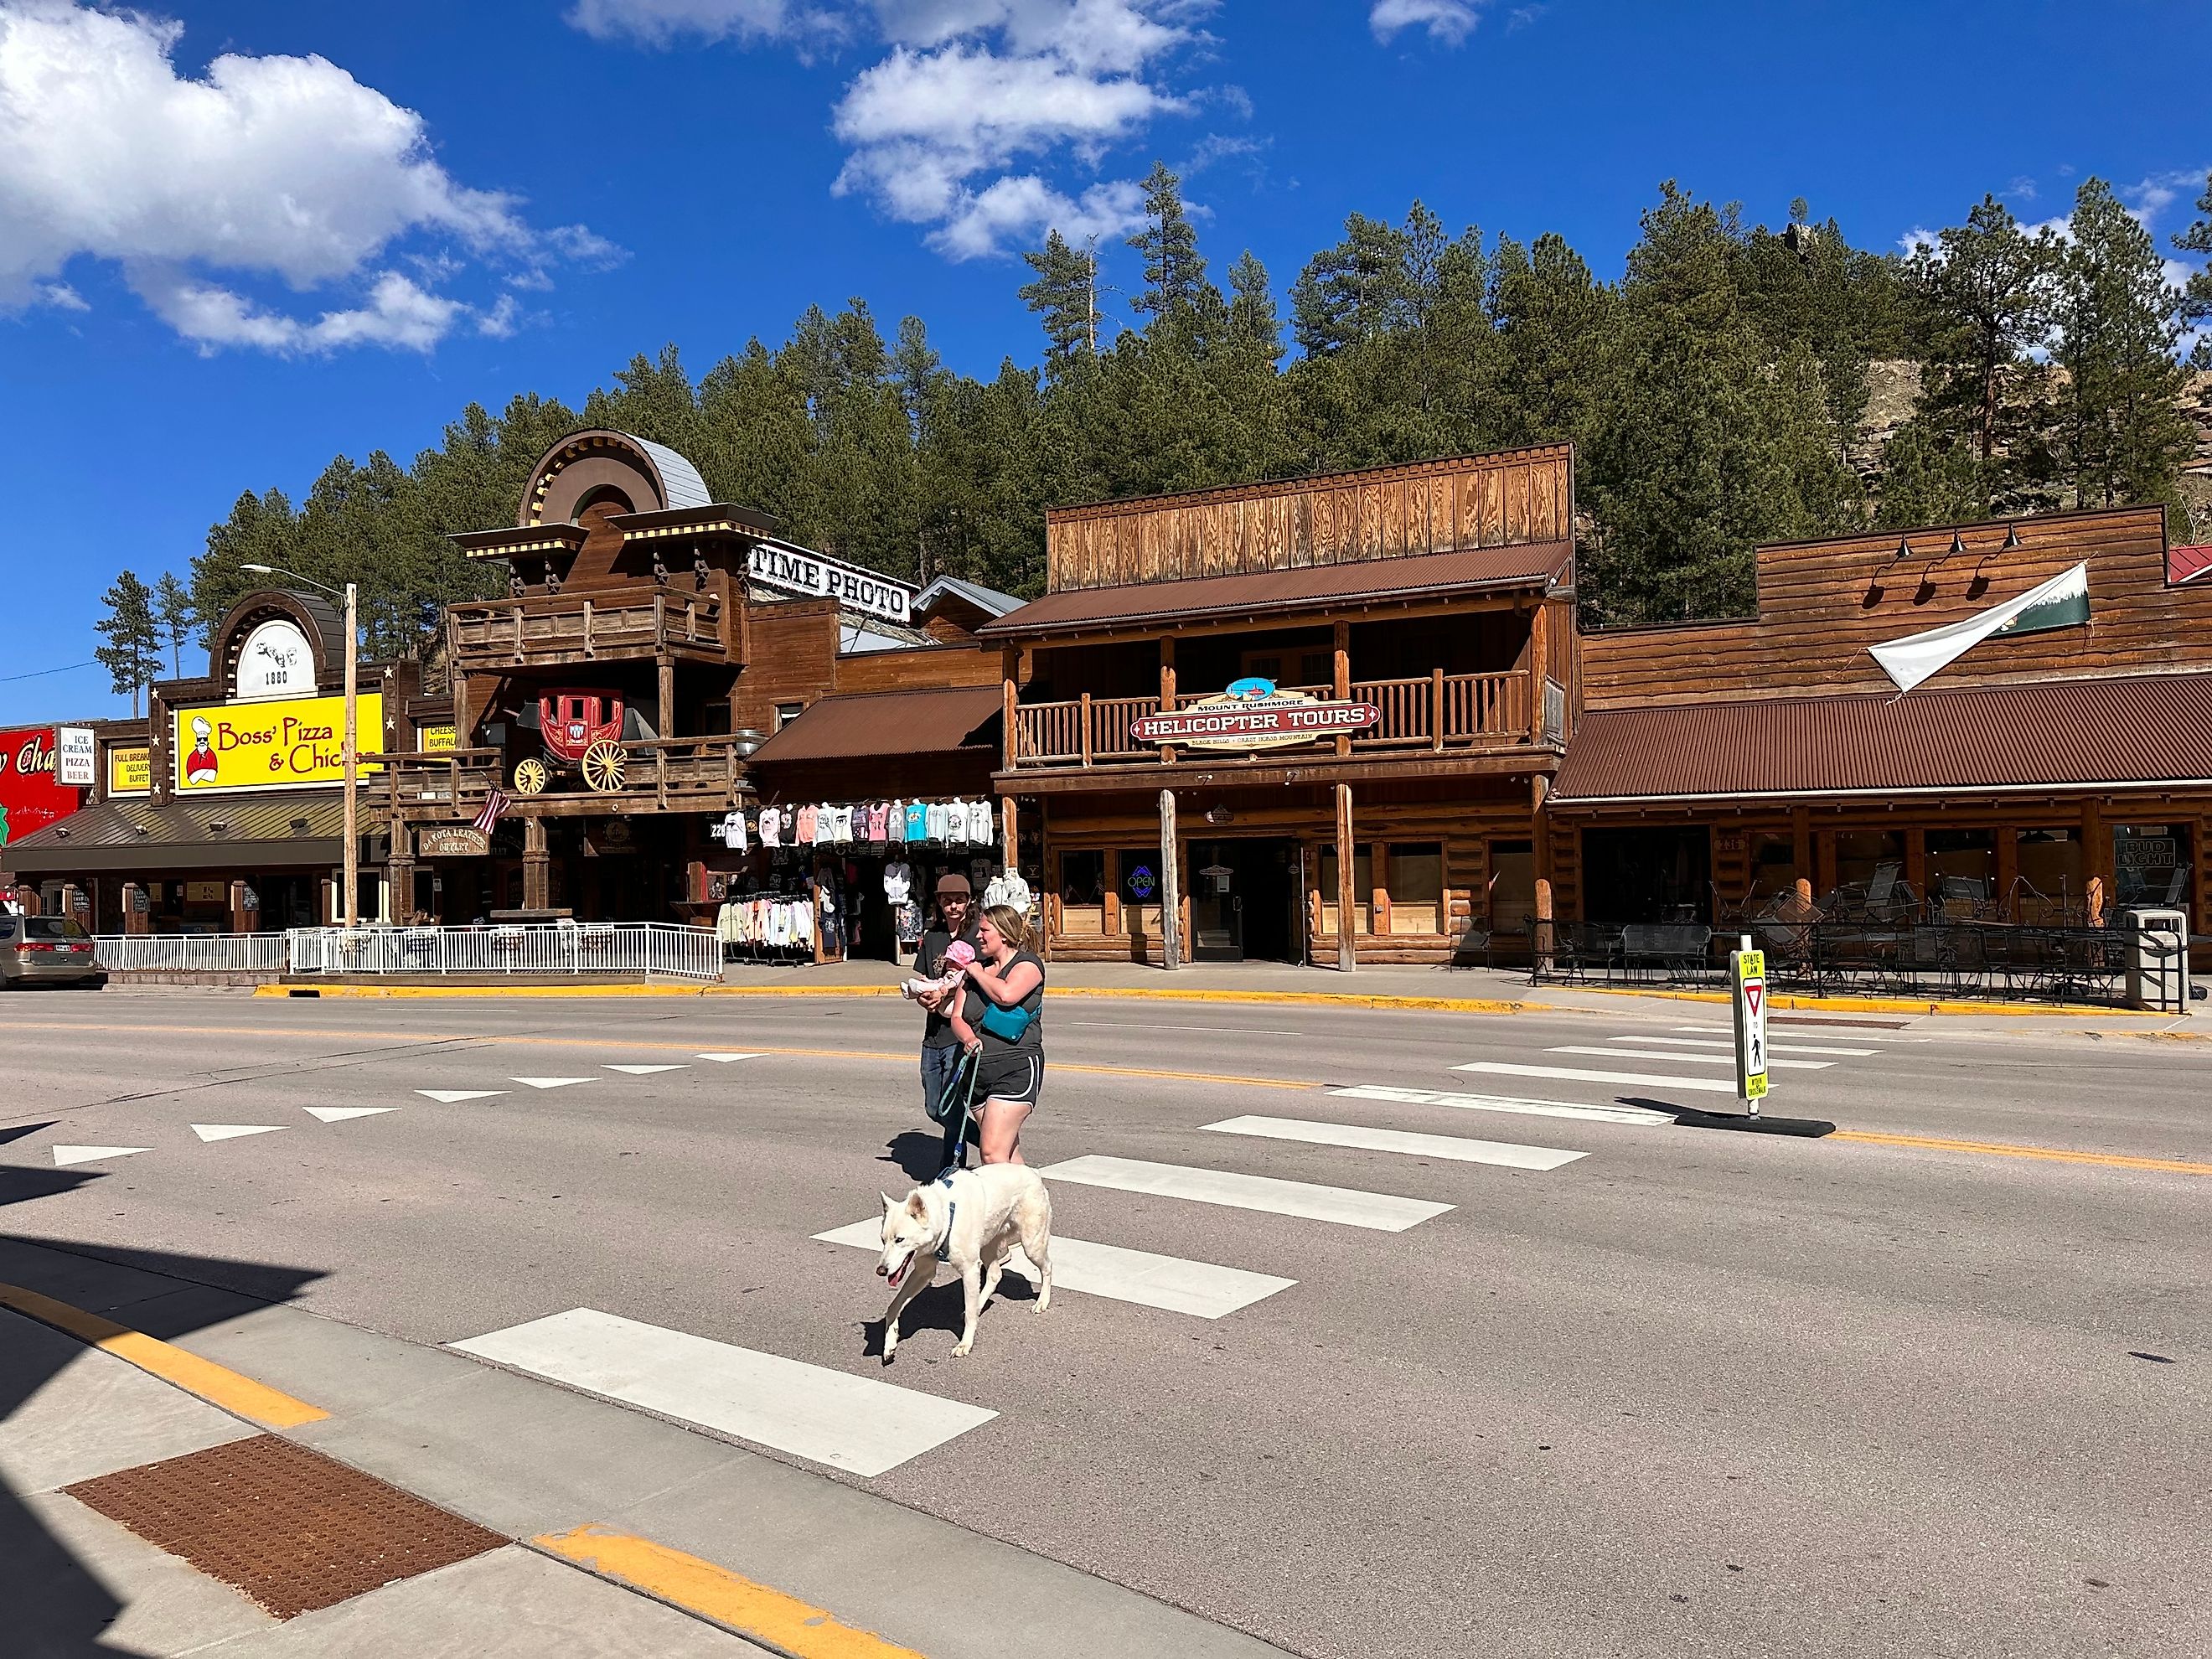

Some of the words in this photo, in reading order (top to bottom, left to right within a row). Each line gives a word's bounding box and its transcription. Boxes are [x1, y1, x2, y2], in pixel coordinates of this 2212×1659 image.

[751, 546, 820, 589] TIME
[826, 568, 903, 614] PHOTO
[266, 671, 287, 685] 1880
[1197, 703, 1238, 712] MOUNT
[1242, 700, 1305, 710] RUSHMORE
[1143, 712, 1279, 736] HELICOPTER
[1287, 707, 1366, 727] TOURS
[218, 722, 276, 751] Boss'
[282, 716, 333, 747] Pizza
[75, 736, 89, 745] ICE
[63, 744, 93, 754] CREAM
[65, 757, 90, 767] PIZZA
[115, 754, 128, 762] FULL
[269, 752, 285, 772] &
[67, 770, 90, 780] BEER
[129, 774, 149, 783] BUFFET
[422, 829, 452, 851] DAKOTA
[453, 829, 486, 850] LEATHER
[439, 842, 469, 853] OUTLET
[2126, 840, 2166, 853] BUD
[2117, 853, 2173, 866] LIGHT
[1127, 876, 1155, 887] OPEN
[1743, 954, 1760, 964] STATE
[1746, 965, 1758, 975] LAW
